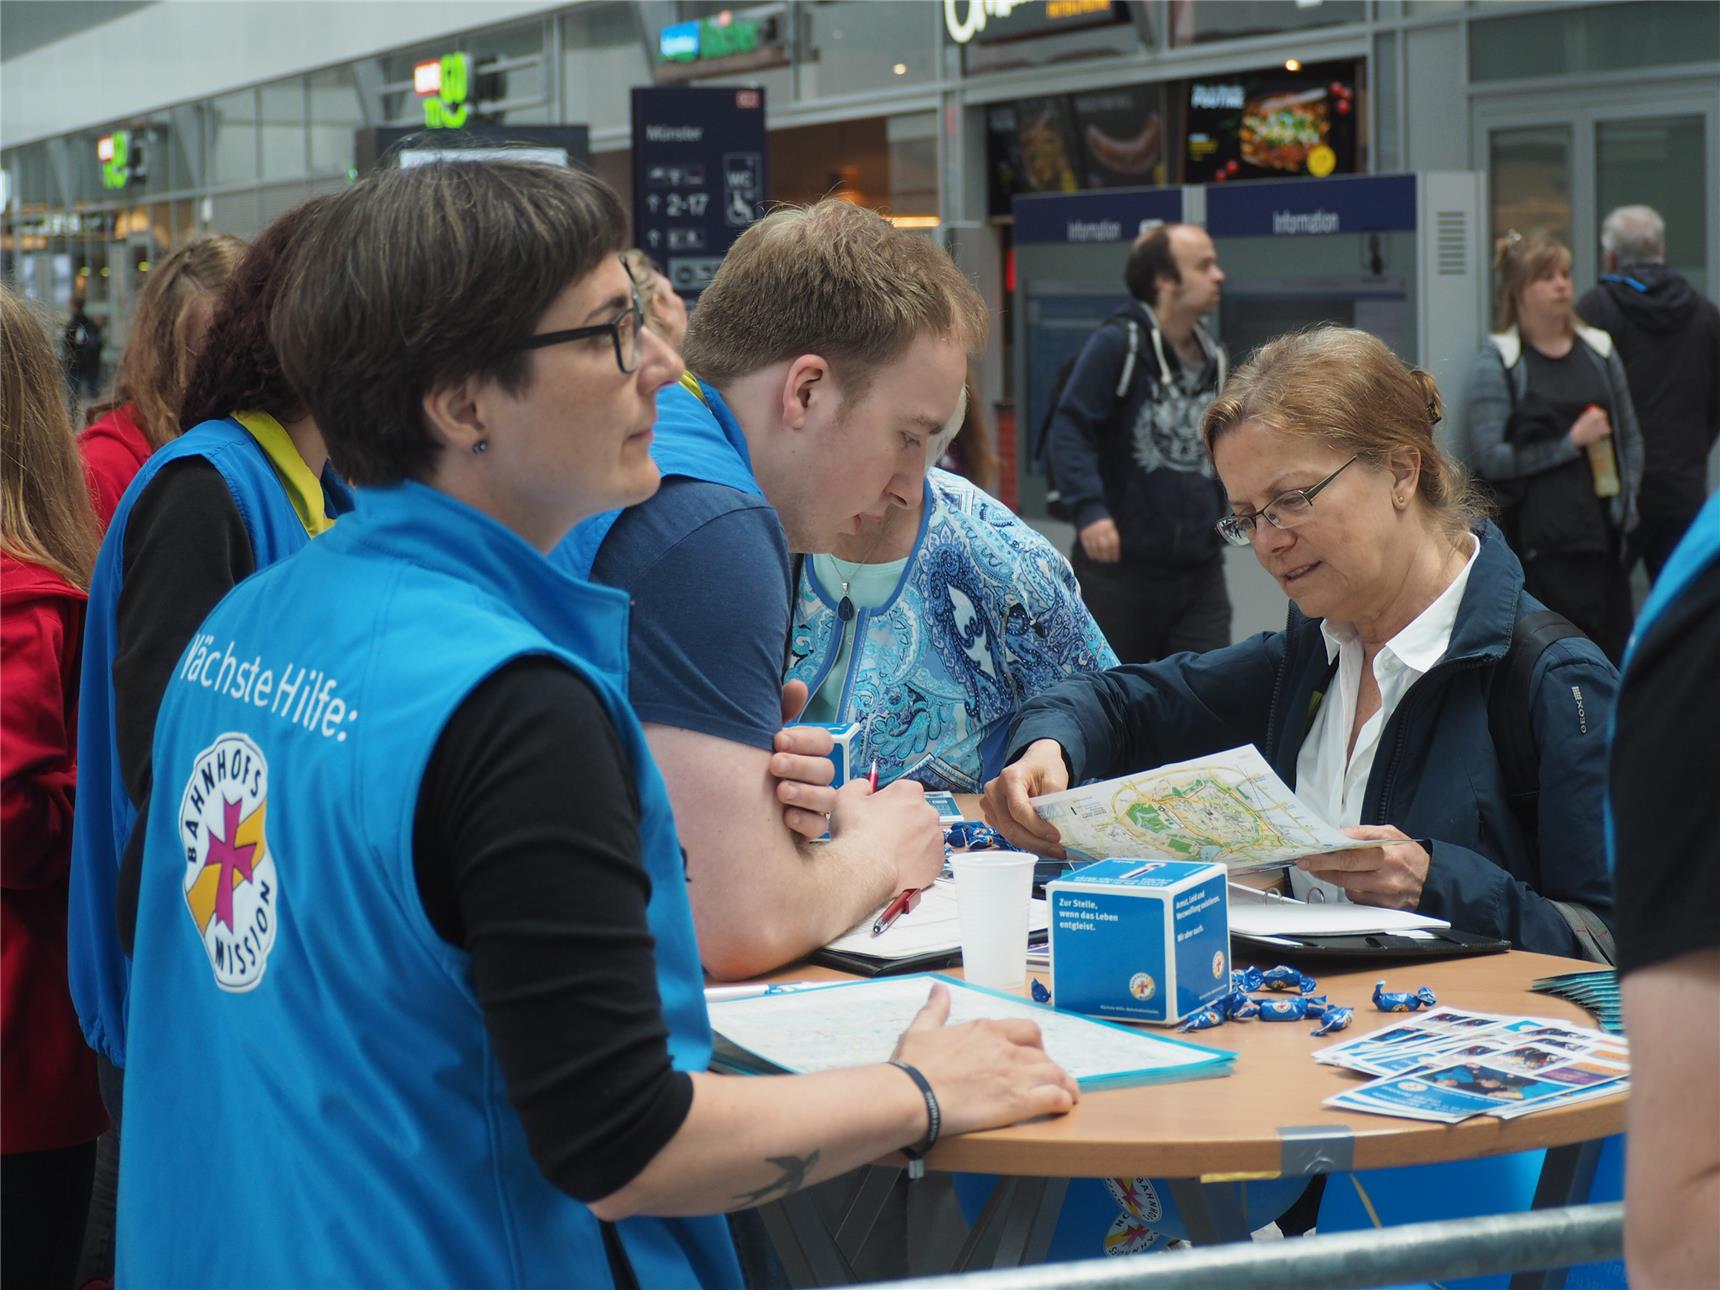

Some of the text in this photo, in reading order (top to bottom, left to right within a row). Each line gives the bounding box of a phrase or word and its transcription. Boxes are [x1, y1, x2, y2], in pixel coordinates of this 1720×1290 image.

[646, 126, 702, 141] Münster
[667, 193, 709, 217] 2-17
[1068, 219, 1121, 241] Information
[1273, 210, 1339, 233] Information
[181, 634, 358, 742] Nächste Hilfe:
[187, 748, 262, 863] BAHNHOFS
[1059, 898, 1098, 910] Zur Stelle,
[1059, 921, 1096, 931] entgleist.
[1081, 911, 1095, 920] das
[1095, 912, 1119, 921] Leben
[214, 880, 270, 976] MISSION
